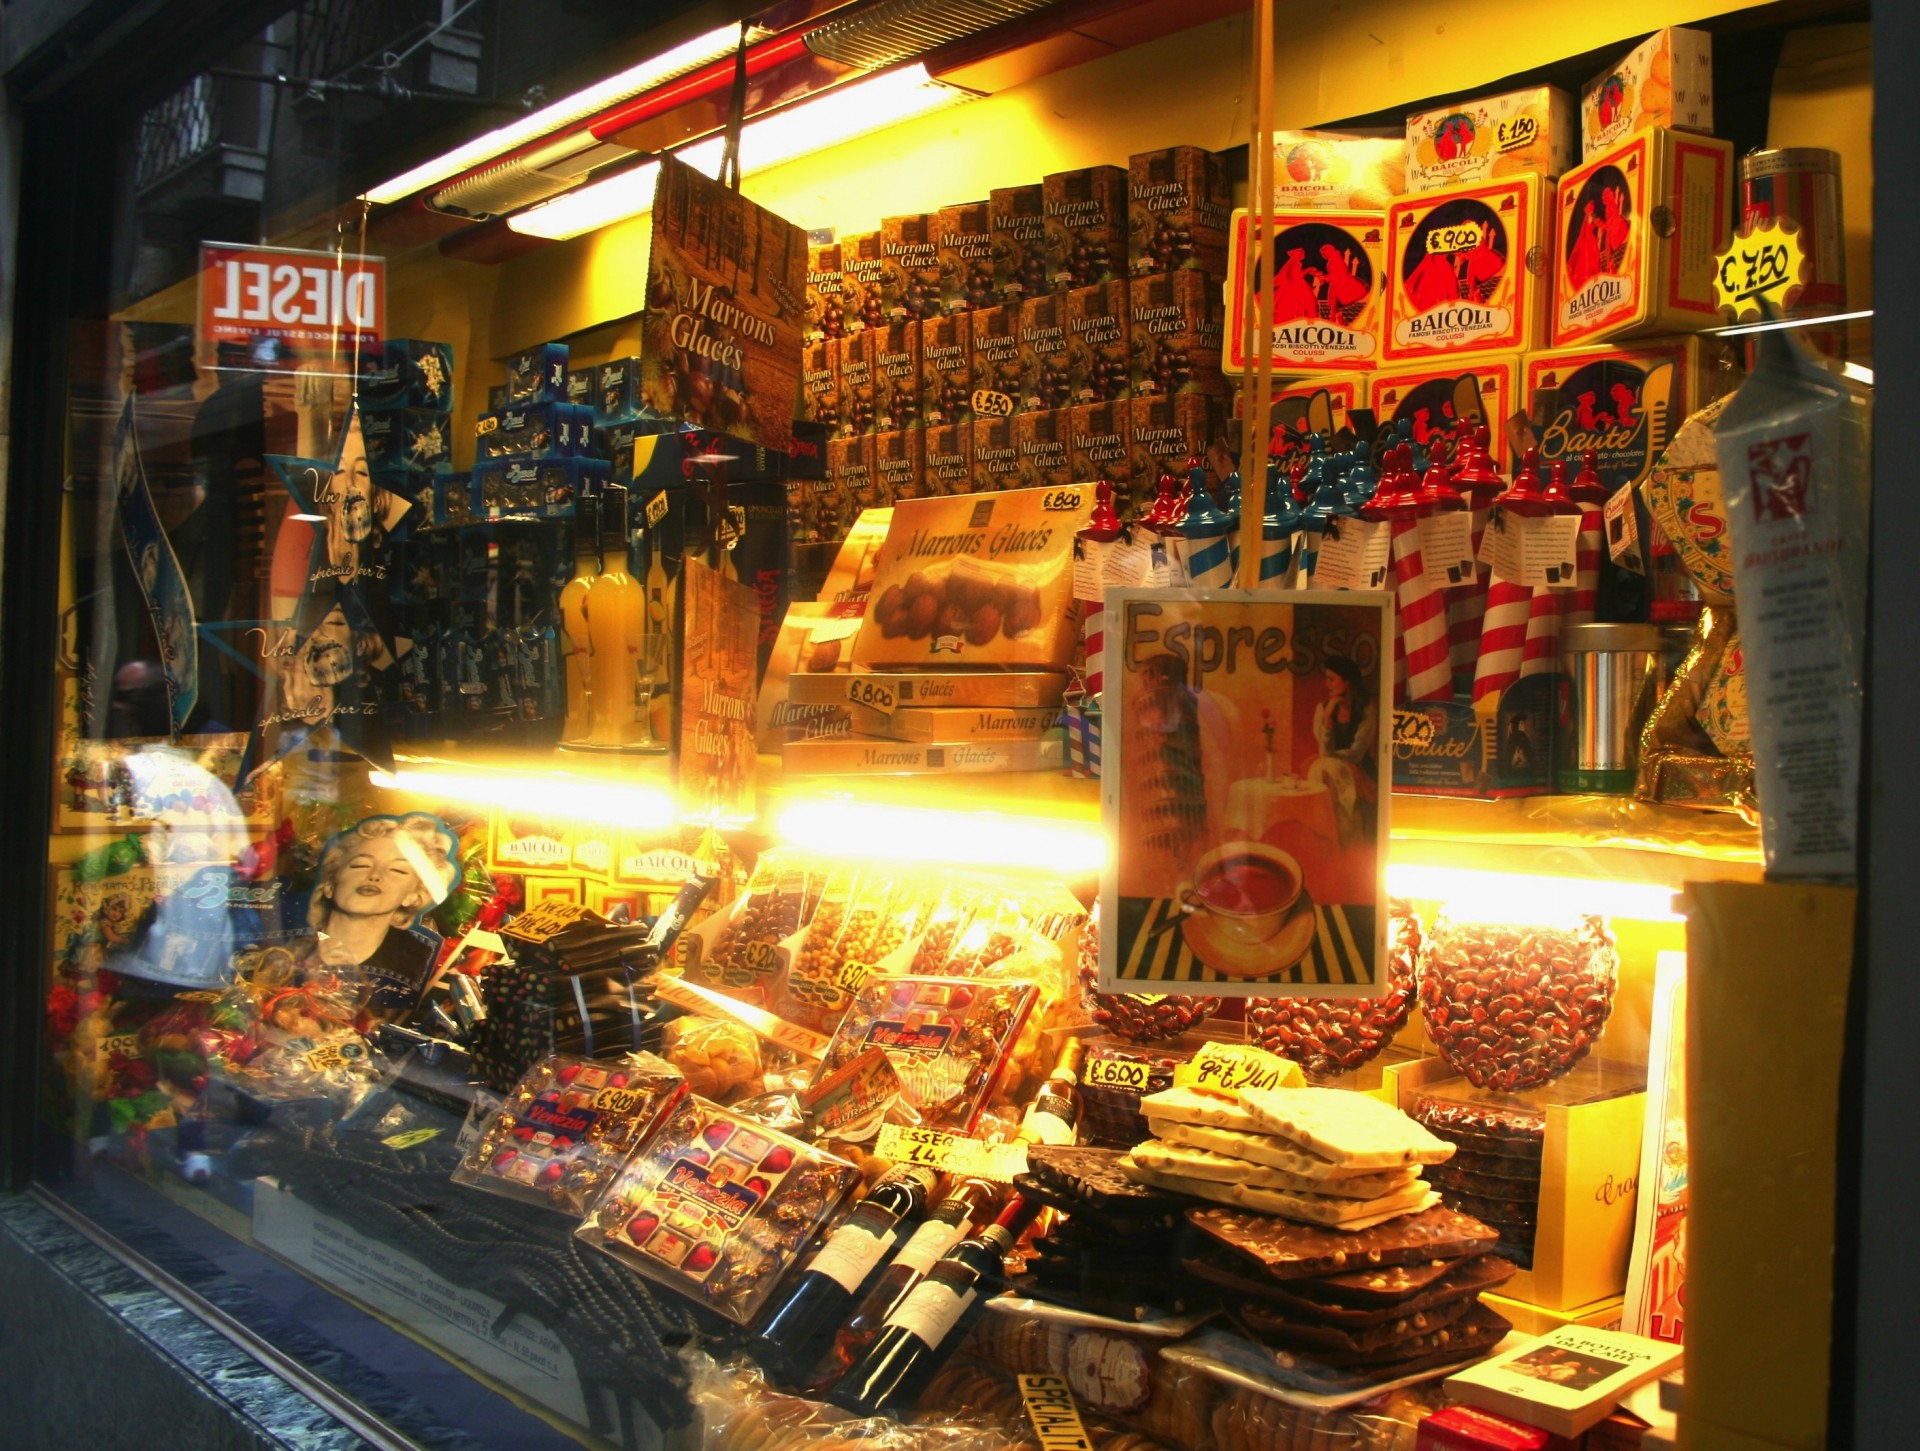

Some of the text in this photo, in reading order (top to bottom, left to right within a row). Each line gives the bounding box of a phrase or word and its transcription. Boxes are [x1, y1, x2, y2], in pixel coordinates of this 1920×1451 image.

[1432, 158, 1478, 172] BAICOLI
[1133, 182, 1184, 200] Marrons
[1048, 200, 1100, 216] Marrons
[1148, 192, 1189, 212] Glacés
[995, 215, 1044, 230] Marron
[1064, 211, 1106, 228] Glacés
[941, 233, 992, 248] Marron
[1013, 227, 1044, 241] Glac
[884, 242, 936, 256] Marrons
[960, 244, 992, 259] Glac
[844, 258, 882, 274] Marron
[858, 270, 882, 283] Glac
[818, 281, 842, 294] Glac
[1570, 281, 1621, 314] BAICOLI
[683, 276, 776, 347] Marrons
[1133, 304, 1182, 322] Marrons
[1411, 308, 1491, 332] BAICOLI
[1072, 314, 1116, 332] Marrons
[1149, 317, 1187, 334] Glacés
[1408, 323, 1493, 338] FAMOSI BISCOTTI VENEZIANI
[1022, 325, 1063, 341] Marrons
[1085, 327, 1121, 344] Glacés
[1436, 333, 1465, 341] COLUSSI
[671, 314, 743, 371] Glacés
[976, 335, 1015, 350] Marrons
[1034, 336, 1067, 353] Glacés
[878, 350, 910, 366] Marrons
[926, 345, 962, 360] Marrons
[987, 344, 1019, 362] Glacés
[842, 361, 868, 375] Marrons
[887, 362, 913, 378] Glacés
[936, 355, 967, 371] Glacés
[804, 368, 832, 384] Marrons
[1075, 433, 1121, 449] Marrons
[1134, 427, 1183, 442] Marrons
[1539, 408, 1633, 459] Baute
[976, 447, 1016, 462] Marrons
[1022, 440, 1064, 456] Marrons
[1089, 446, 1126, 461] Glacés
[1150, 437, 1188, 455] Glacés
[878, 458, 911, 471] Marrons
[928, 453, 964, 467] Marrons
[988, 456, 1020, 473] Glacés
[1034, 450, 1068, 467] Glacés
[887, 468, 914, 483] Glacés
[938, 464, 968, 479] Glacés
[896, 520, 1053, 562] Marrons Glacés
[310, 552, 351, 592] speciale
[1126, 603, 1378, 688] Espresso
[920, 679, 955, 698] Glacés
[700, 678, 745, 721] Marrons
[258, 695, 326, 736] speciale
[971, 712, 1062, 733] Marrons Gla
[805, 713, 852, 739] Glacé
[695, 718, 729, 757] Glacés
[857, 748, 997, 767] Marrons Glacés
[183, 873, 283, 908] Baci
[873, 1026, 945, 1049] Venezia
[529, 1104, 588, 1132] Venezia
[673, 1166, 748, 1215] Venezia
[1025, 1376, 1087, 1451] SPECIALIT
